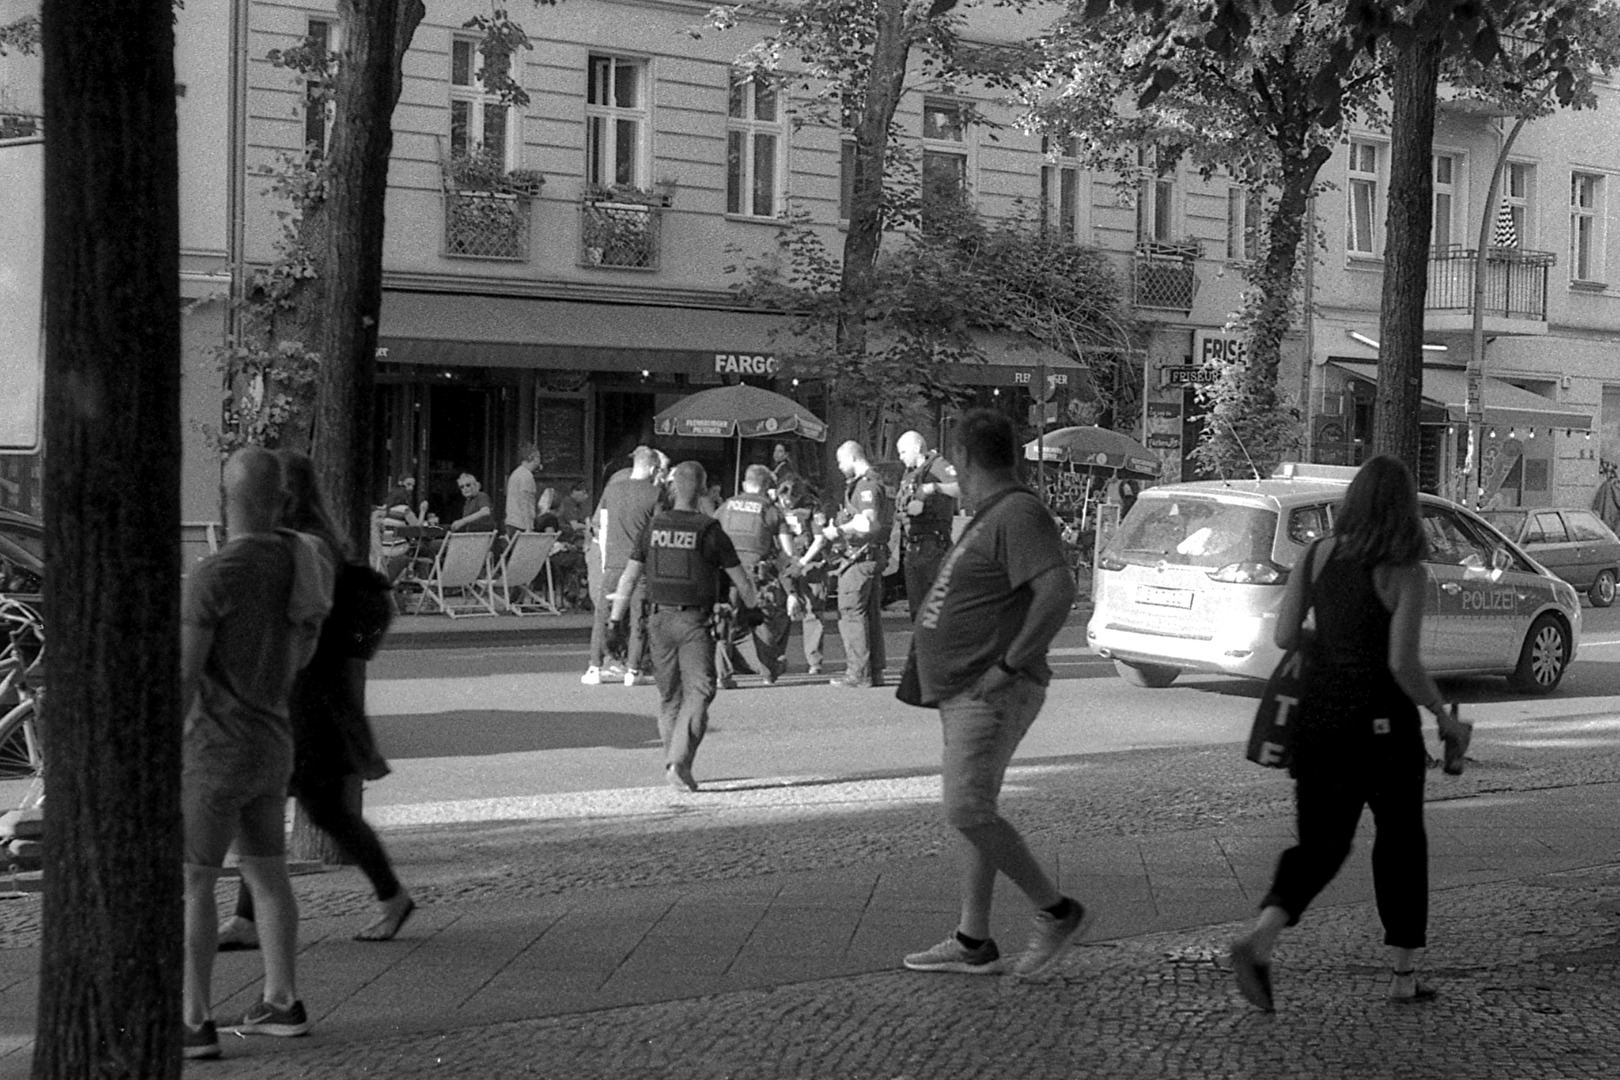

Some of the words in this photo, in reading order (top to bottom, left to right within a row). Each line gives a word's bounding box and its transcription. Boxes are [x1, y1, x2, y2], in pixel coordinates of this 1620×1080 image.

[1172, 371, 1219, 382] FRISEUR
[726, 499, 763, 514] POLIZEI
[650, 529, 698, 549] POLIZEI
[1462, 590, 1515, 610] POLIZEI
